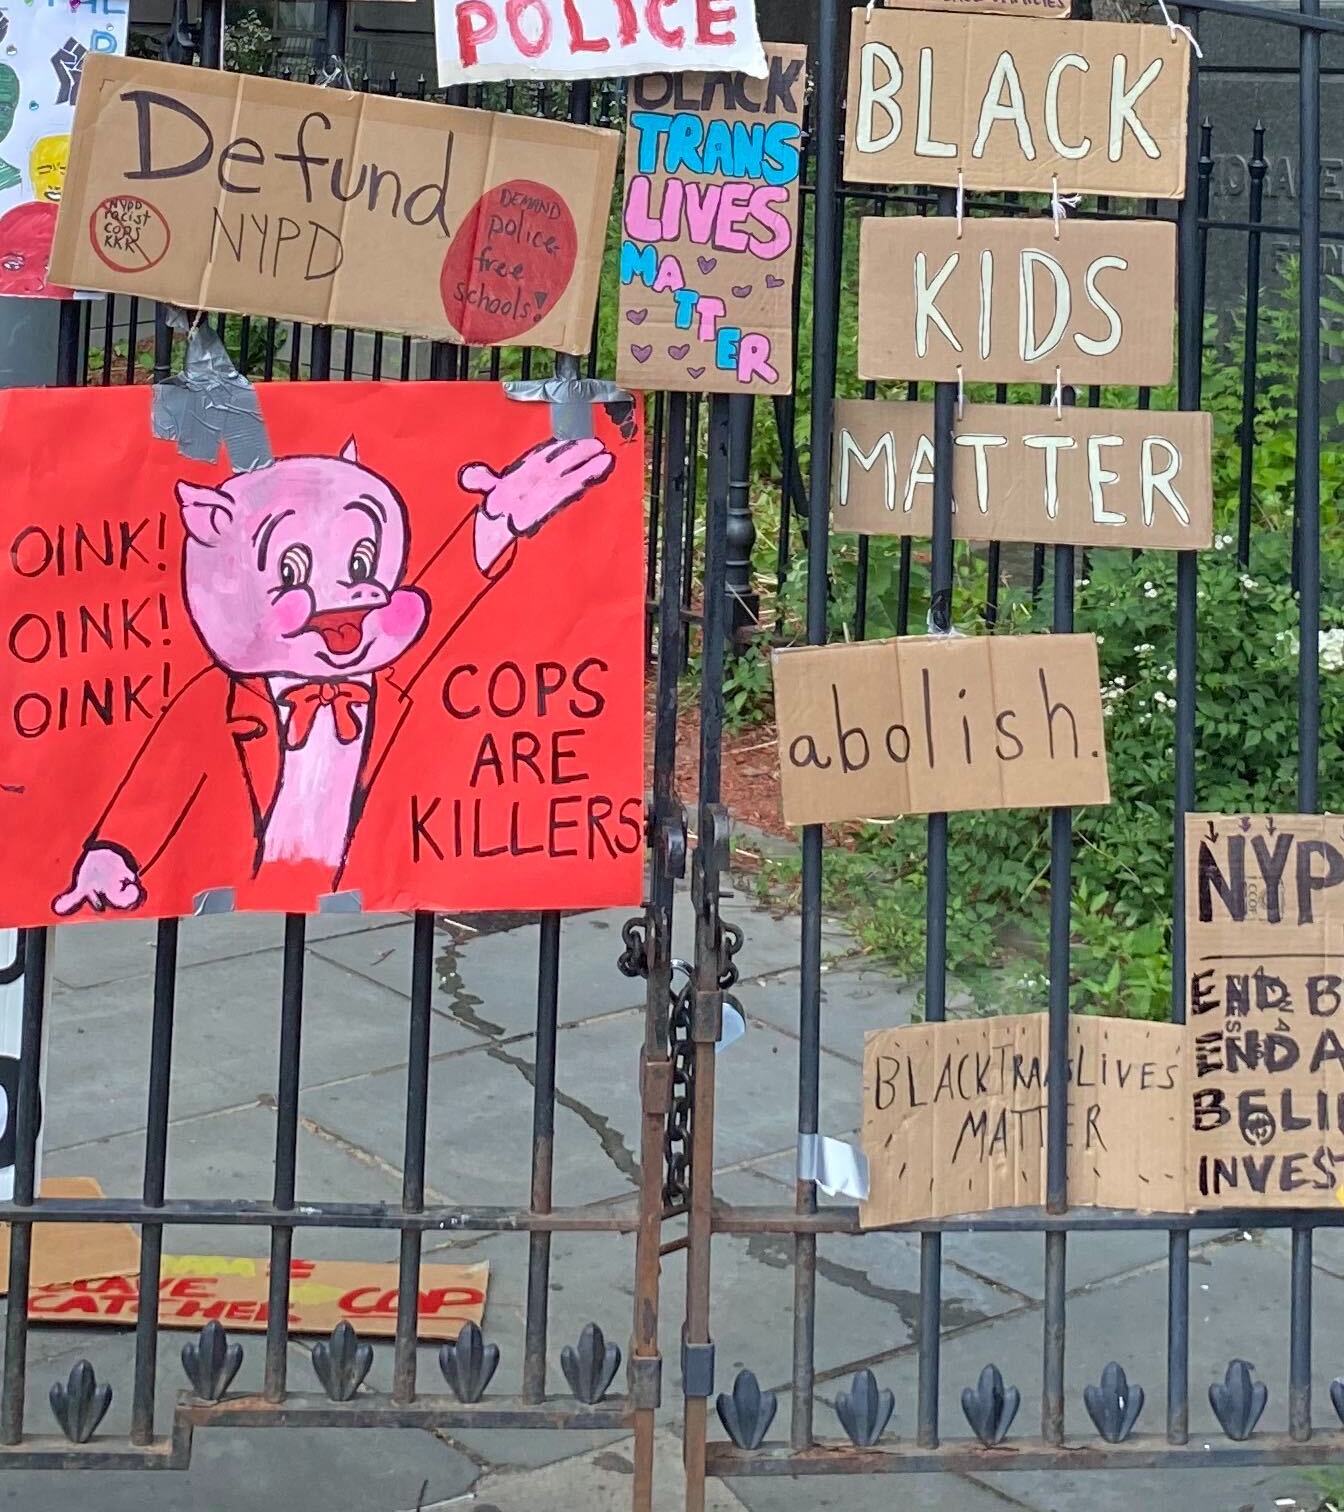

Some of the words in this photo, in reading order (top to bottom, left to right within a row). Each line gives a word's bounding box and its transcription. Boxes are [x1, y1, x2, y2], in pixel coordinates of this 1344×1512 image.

[855, 41, 1164, 163] BLACK
[120, 90, 452, 239] Defund
[631, 111, 801, 186] TRANS
[500, 189, 561, 219] DEMAND
[624, 175, 792, 260] LIVES
[209, 206, 344, 281] NYPD
[475, 246, 523, 279] free
[620, 240, 778, 384] MATTER
[913, 247, 1128, 362] KIDS
[839, 427, 1190, 527] MATTER
[10, 511, 169, 577] OINK!
[8, 594, 171, 663] OINK!
[13, 664, 174, 738] OINK!
[443, 658, 608, 720] COPS
[469, 729, 589, 786] ARE
[412, 796, 642, 864] KILLERS
[1191, 967, 1292, 1016] END
[875, 1050, 991, 1110] BLACK
[1196, 1029, 1301, 1078] END
